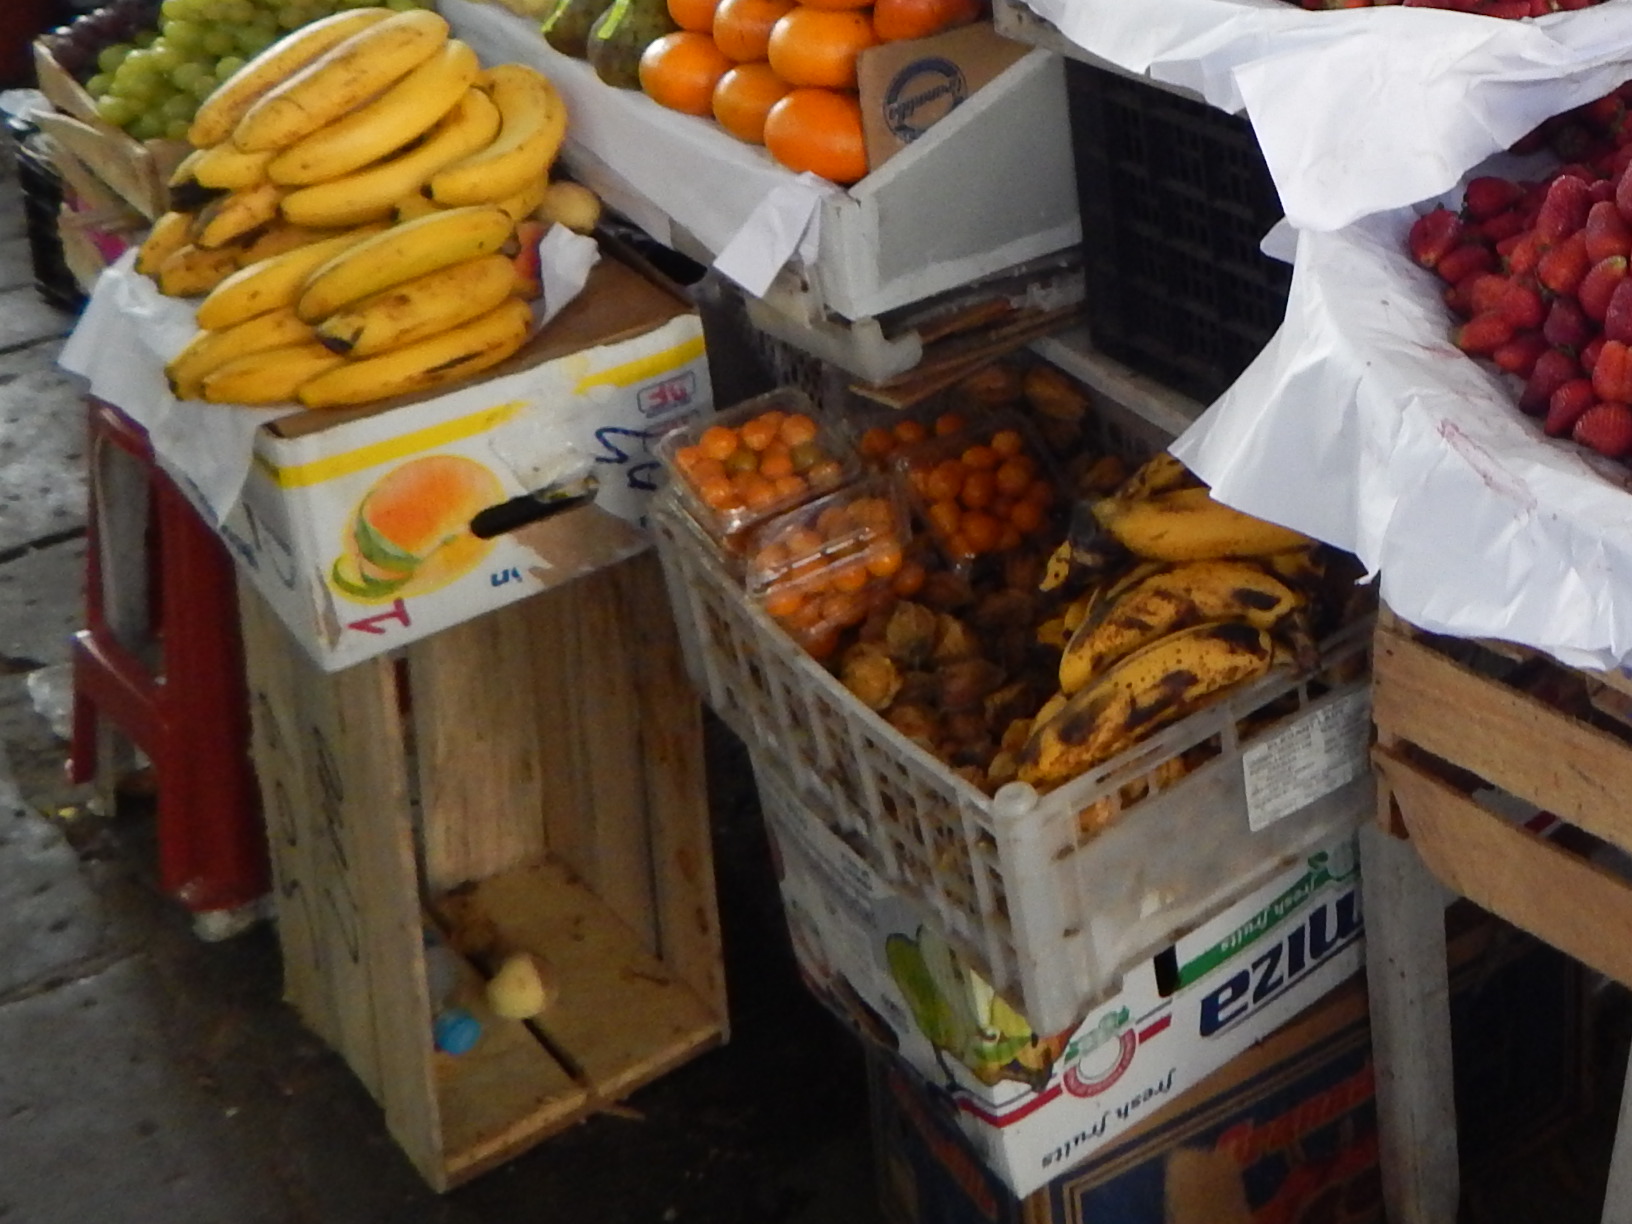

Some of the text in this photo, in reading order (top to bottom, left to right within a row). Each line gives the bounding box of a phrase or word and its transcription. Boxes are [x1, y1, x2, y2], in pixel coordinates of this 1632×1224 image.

[1220, 910, 1269, 953] fruits
[1042, 1068, 1176, 1167] fresh fruits
